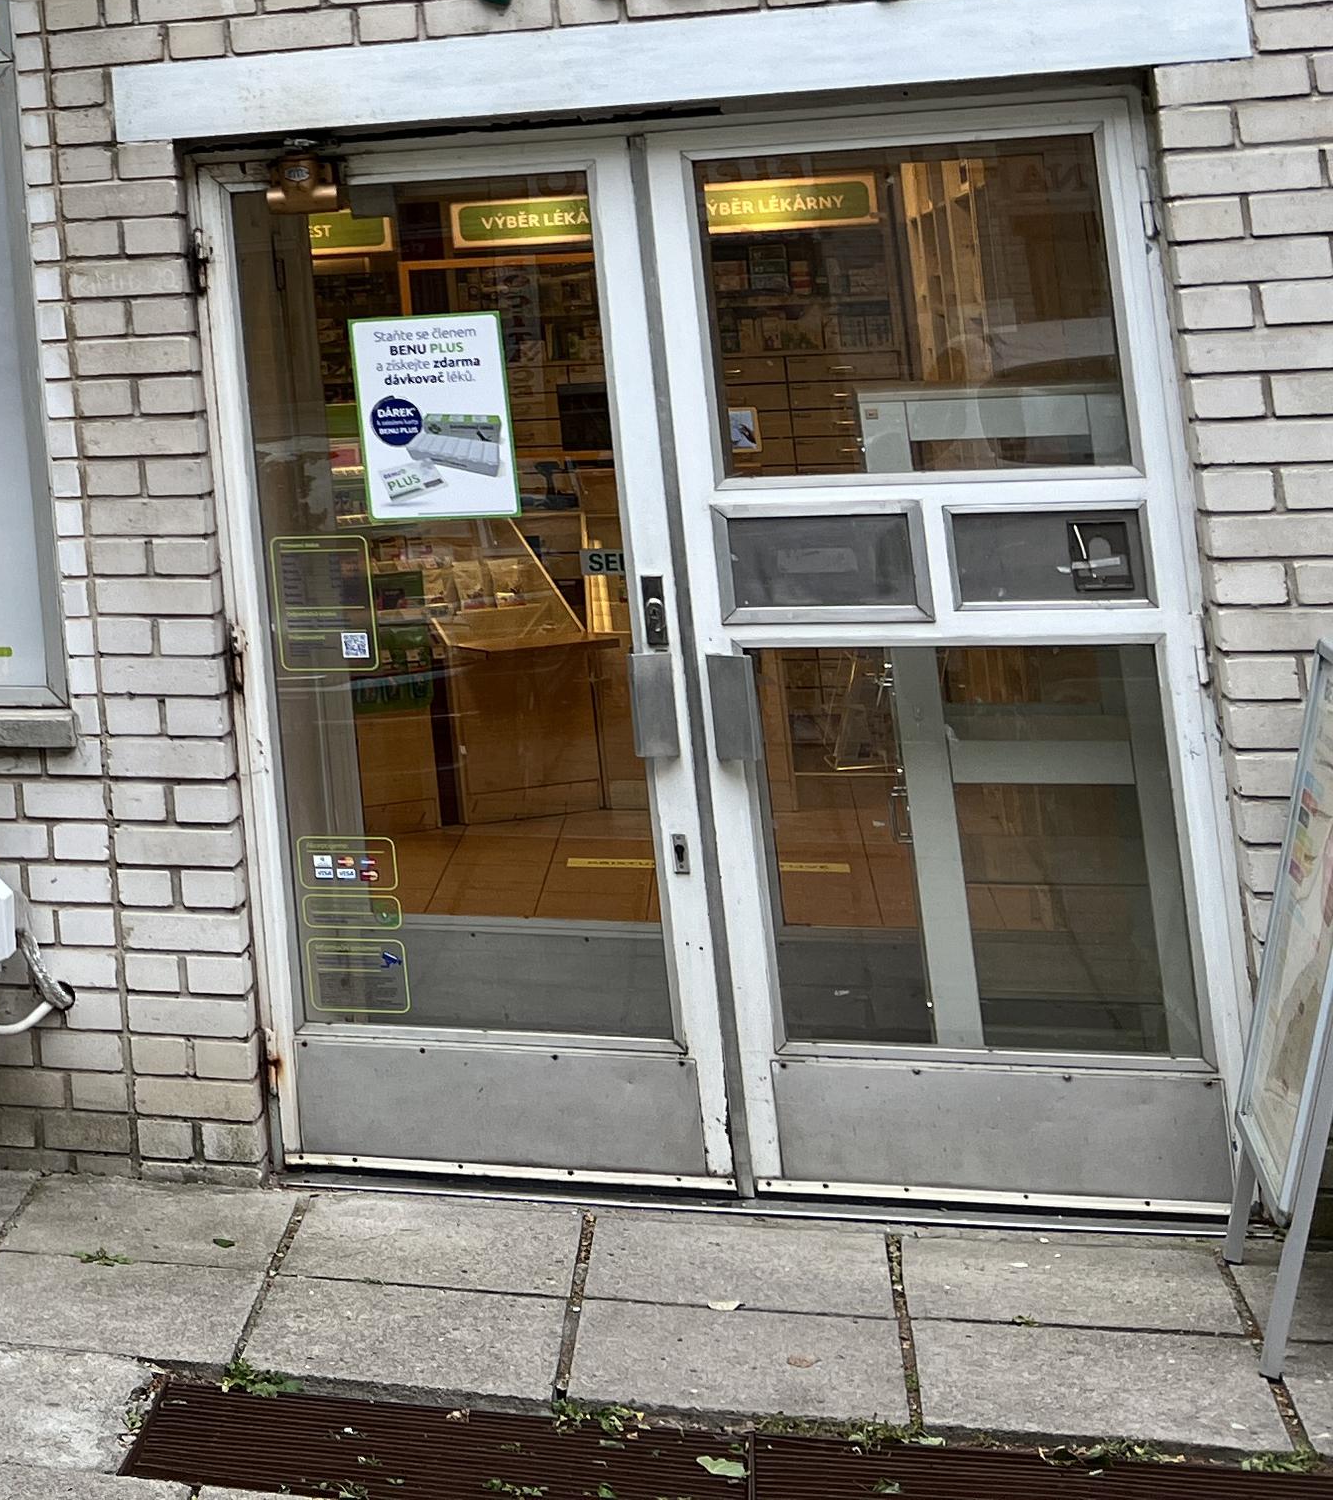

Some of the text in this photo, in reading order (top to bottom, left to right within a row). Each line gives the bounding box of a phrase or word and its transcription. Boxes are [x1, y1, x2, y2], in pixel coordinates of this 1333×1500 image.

[758, 193, 844, 213] LÉKÁRNY
[481, 211, 540, 229] VÝBĚR
[373, 328, 477, 342] Staňte se členem
[389, 342, 464, 356] BENU PLUS
[376, 357, 481, 372] a získejte zdarma
[384, 371, 445, 385] dávkovač
[387, 474, 421, 491] PLUS
